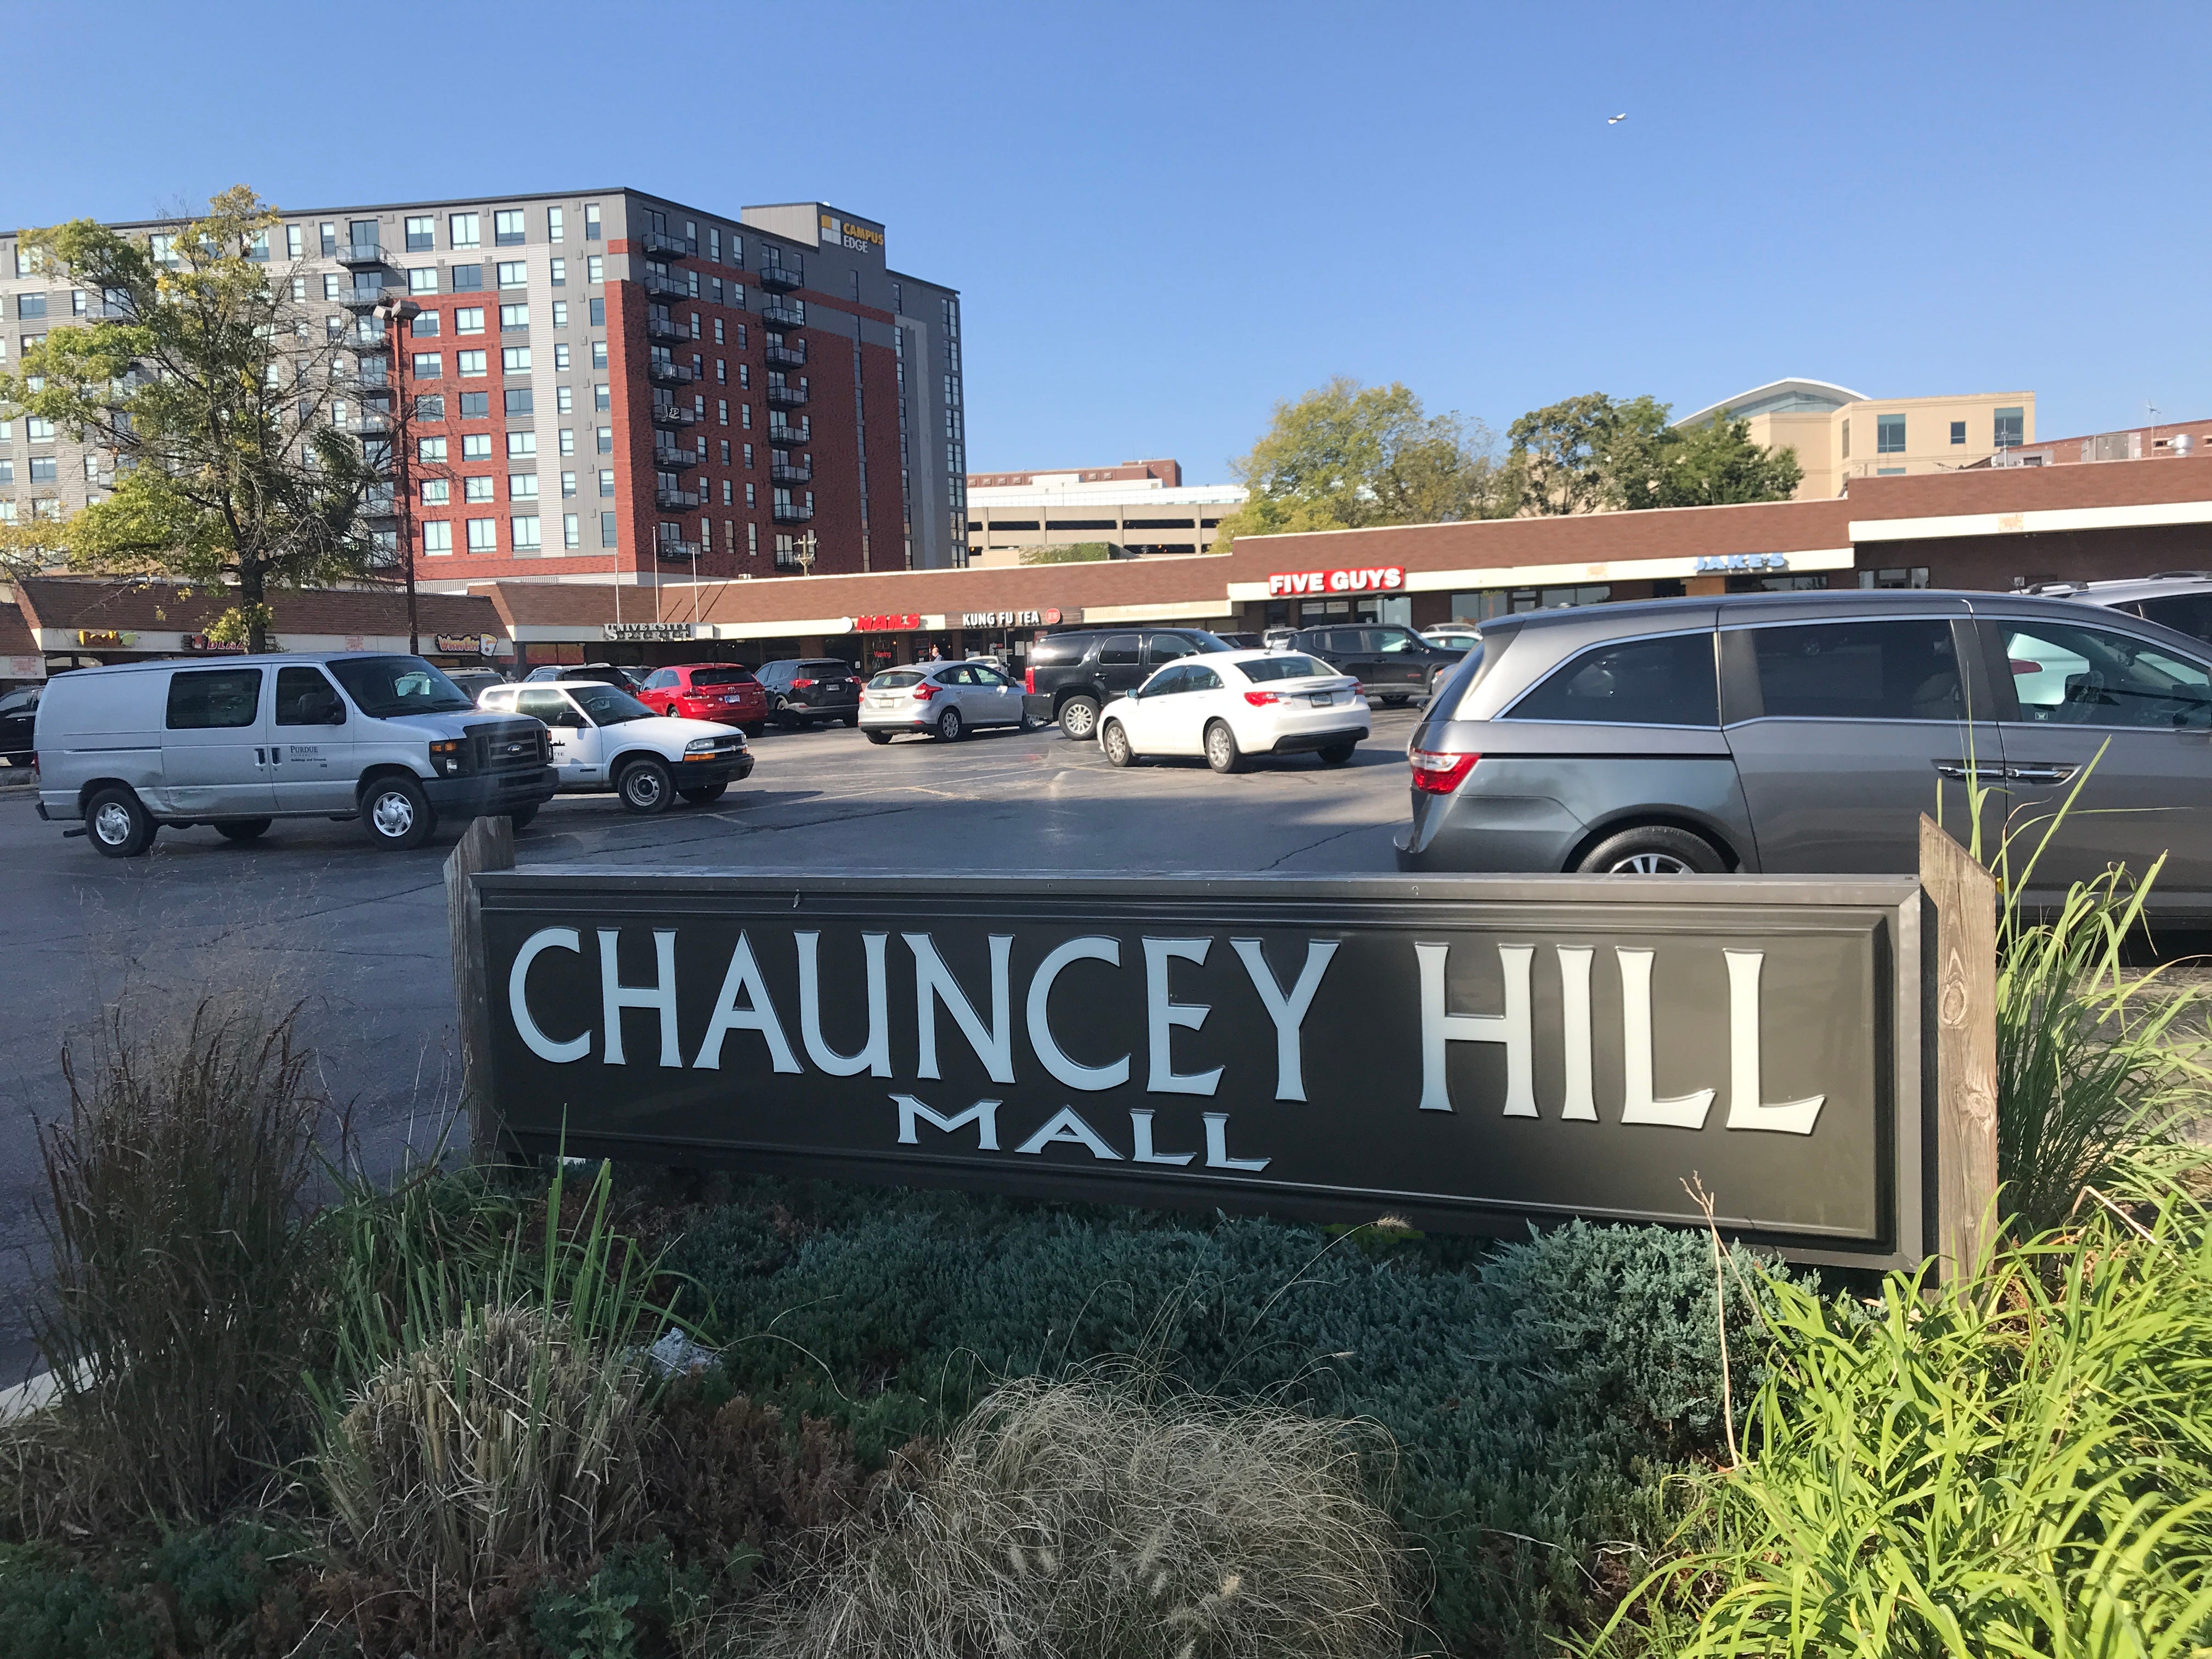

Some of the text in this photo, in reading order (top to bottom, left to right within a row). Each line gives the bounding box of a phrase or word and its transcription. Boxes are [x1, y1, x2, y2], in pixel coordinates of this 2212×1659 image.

[843, 222, 884, 246] CAMPUS
[843, 235, 868, 253] EDGE
[1269, 568, 1402, 594] FIVE GUYS
[603, 623, 687, 631] UNIVERSITY
[856, 613, 921, 631] NAILS
[962, 612, 996, 627] KUNG
[998, 611, 1013, 624] FU
[1017, 611, 1040, 624] TEA
[507, 926, 1828, 1137] CHAUNCEY HILL
[888, 1093, 1273, 1172] MALL
